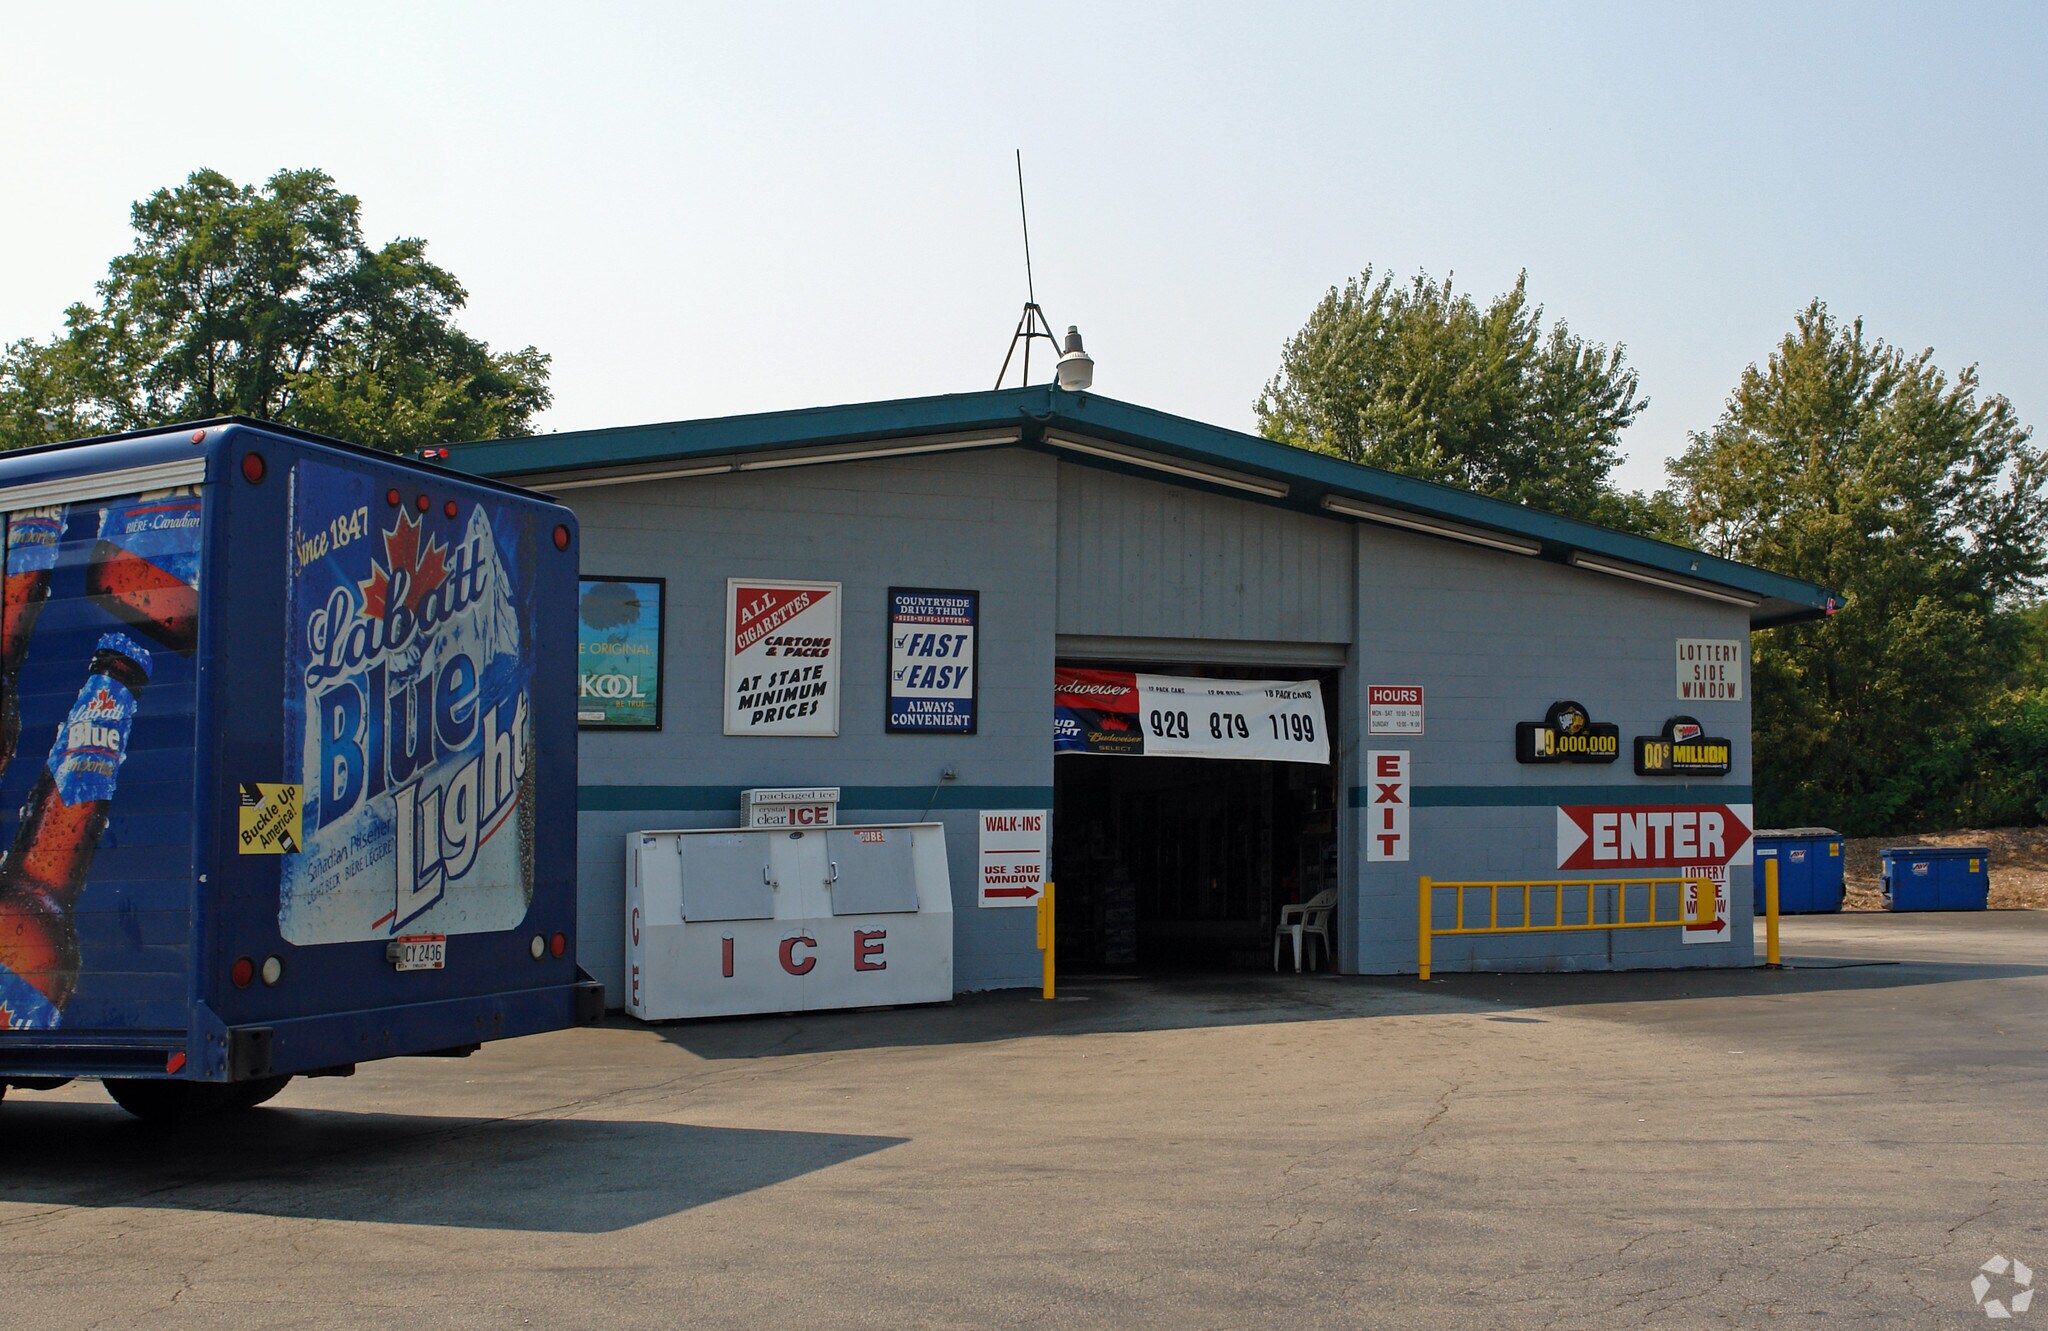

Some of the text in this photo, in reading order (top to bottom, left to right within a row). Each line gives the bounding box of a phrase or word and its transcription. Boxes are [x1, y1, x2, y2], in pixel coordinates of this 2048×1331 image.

[126, 509, 200, 534] BIÈRE Canadian
[294, 506, 368, 577] Since 1847
[741, 593, 777, 625] ALL
[895, 596, 970, 608] COUNTRYSIDE
[900, 605, 965, 616] DRIVE THRU
[305, 533, 489, 690] Labatt
[737, 592, 811, 649] CIGARETTES
[764, 636, 831, 648] CARTONS
[907, 633, 968, 658] FAST
[765, 647, 830, 658] & PACKS
[1680, 644, 1737, 661] LOTTERY
[737, 665, 823, 693] AT STATE
[906, 665, 969, 689] EASY
[1694, 664, 1725, 681] SIDE
[580, 674, 647, 698] KOOL
[1054, 679, 1132, 695] udweiser
[1264, 690, 1312, 700] 18 PACK CANS
[1682, 682, 1736, 698] WINDOW
[738, 681, 827, 710] MINIMUM
[1374, 690, 1418, 702] HOURS
[751, 700, 819, 725] PRICES
[907, 701, 955, 713] ALWAYS
[891, 713, 970, 726] CONVENIENT
[1055, 718, 1076, 728] UD
[1150, 710, 1190, 739] 929
[1209, 712, 1249, 739] 879
[1269, 713, 1315, 742] 1199
[66, 720, 121, 751] Blue
[1054, 727, 1082, 737] GHT
[1087, 731, 1143, 743] Budweiser
[316, 651, 480, 832] Blue
[1673, 745, 1728, 763] MILLION
[759, 790, 836, 801] packaged ice
[390, 688, 530, 934] Light
[1374, 755, 1403, 856] EXIT
[241, 804, 279, 846] Buckle
[277, 786, 296, 806] Up
[757, 813, 787, 825] clear
[789, 806, 829, 825] ICE
[985, 816, 1041, 832] WALK-INS
[260, 802, 297, 849] America!
[1593, 812, 1725, 860] ENTER
[984, 865, 1041, 874] USE SIDE
[1685, 866, 1725, 879] LOTTERY
[985, 875, 1040, 884] WINDOW
[1690, 884, 1722, 899] SE
[419, 944, 442, 962] 2436
[722, 924, 887, 978] ICE
